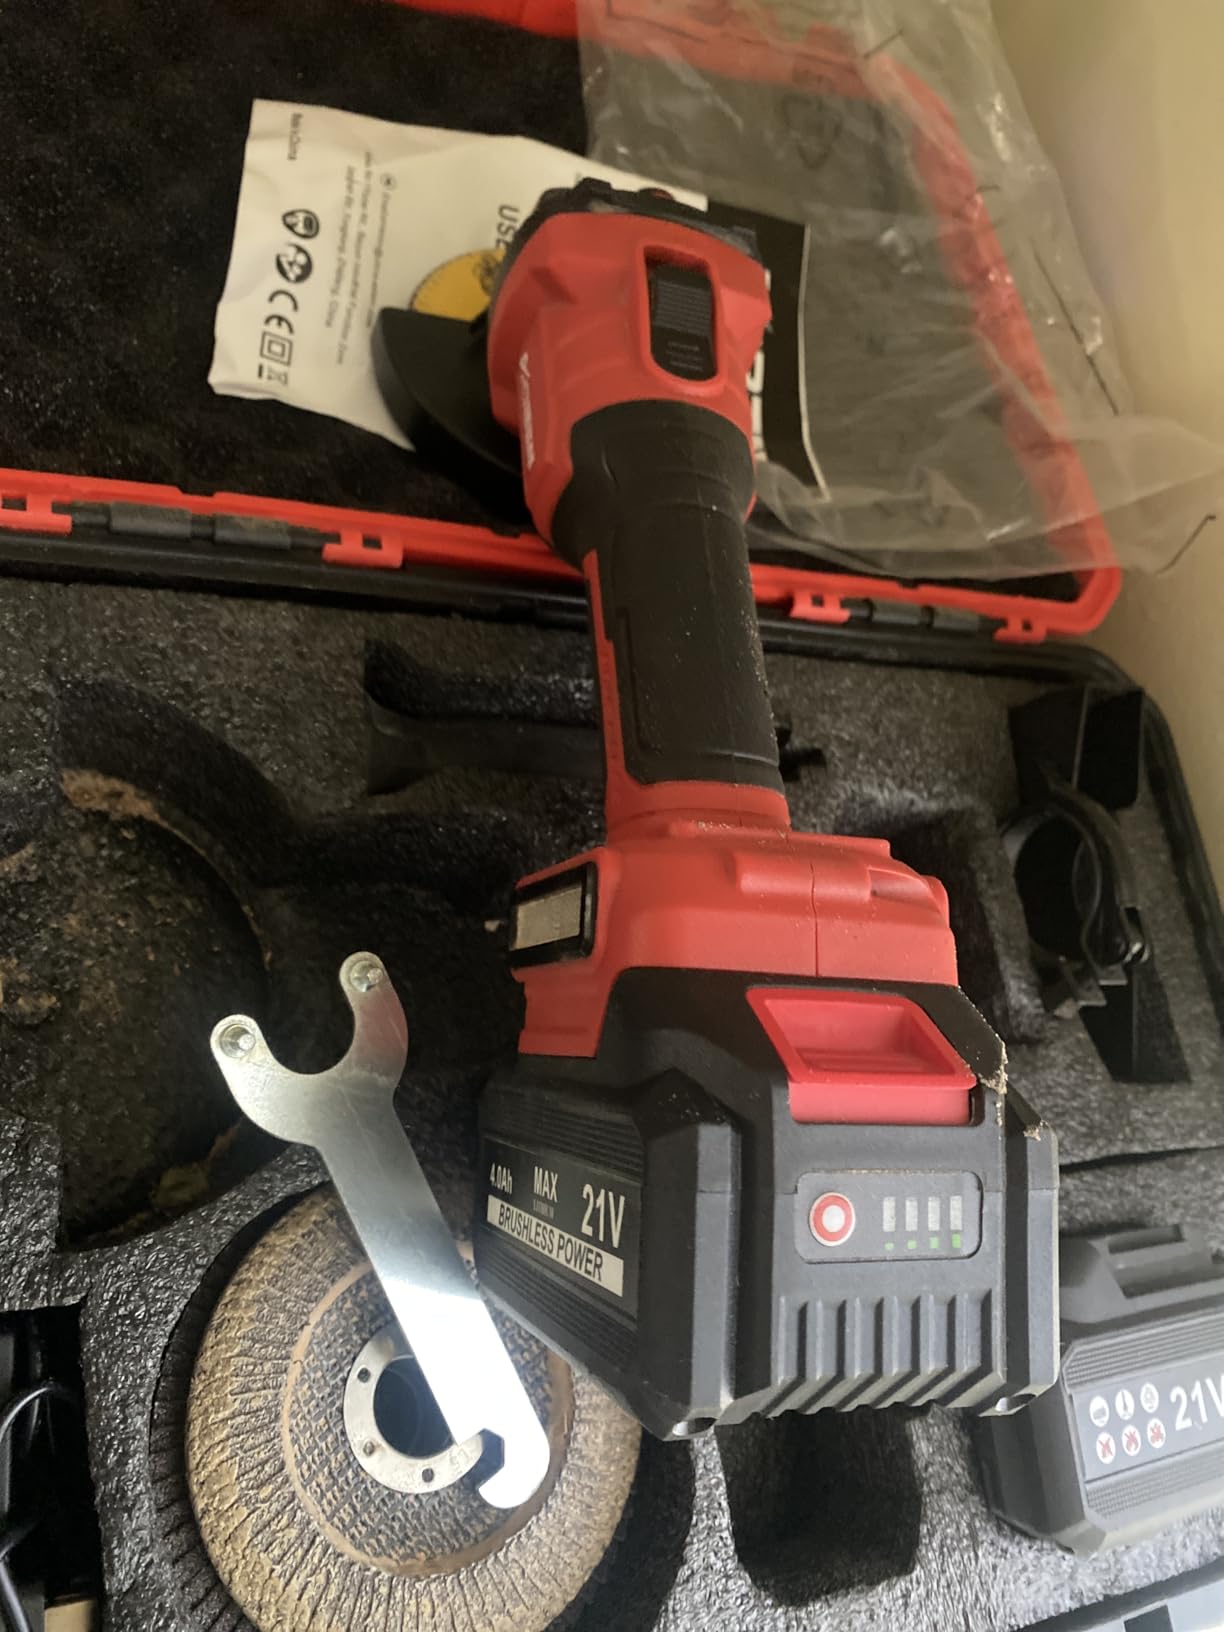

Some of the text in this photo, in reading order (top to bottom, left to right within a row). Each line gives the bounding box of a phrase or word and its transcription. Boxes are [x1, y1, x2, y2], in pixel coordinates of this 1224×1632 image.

[489, 1162, 513, 1195] 4.0Ah
[533, 1166, 558, 1203] MAX
[581, 1183, 626, 1249] 21V
[498, 1203, 555, 1255] BRUSHLESS
[556, 1233, 604, 1282] POWER
